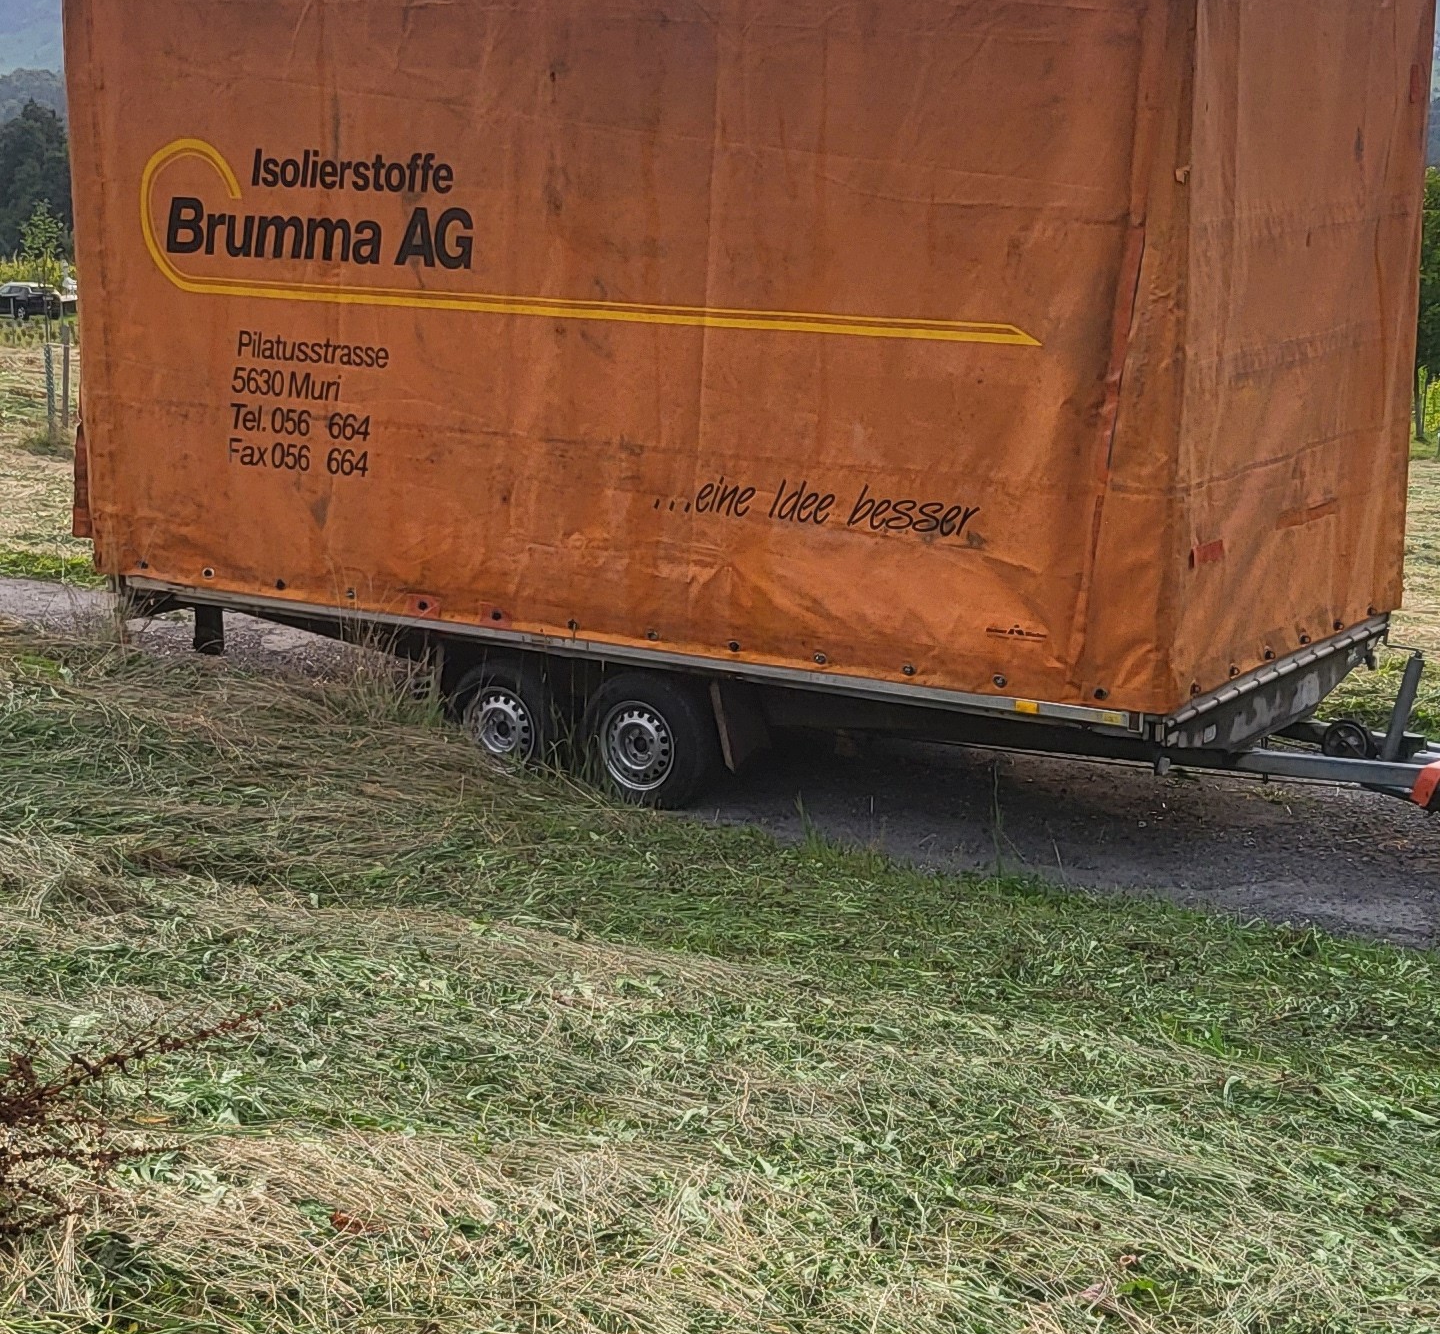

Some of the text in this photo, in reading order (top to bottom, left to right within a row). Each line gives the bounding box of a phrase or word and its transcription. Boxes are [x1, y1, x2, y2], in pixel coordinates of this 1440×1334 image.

[251, 148, 454, 194] Isolierstoffe
[166, 196, 474, 269] Brumma AG
[237, 330, 390, 368] Pilatusstrasse
[231, 367, 342, 402] 5630 Muri
[230, 403, 371, 442] Tel. 056 664
[229, 437, 369, 477] Fax 056 664
[768, 479, 836, 525] Idee
[847, 484, 980, 537] besser
